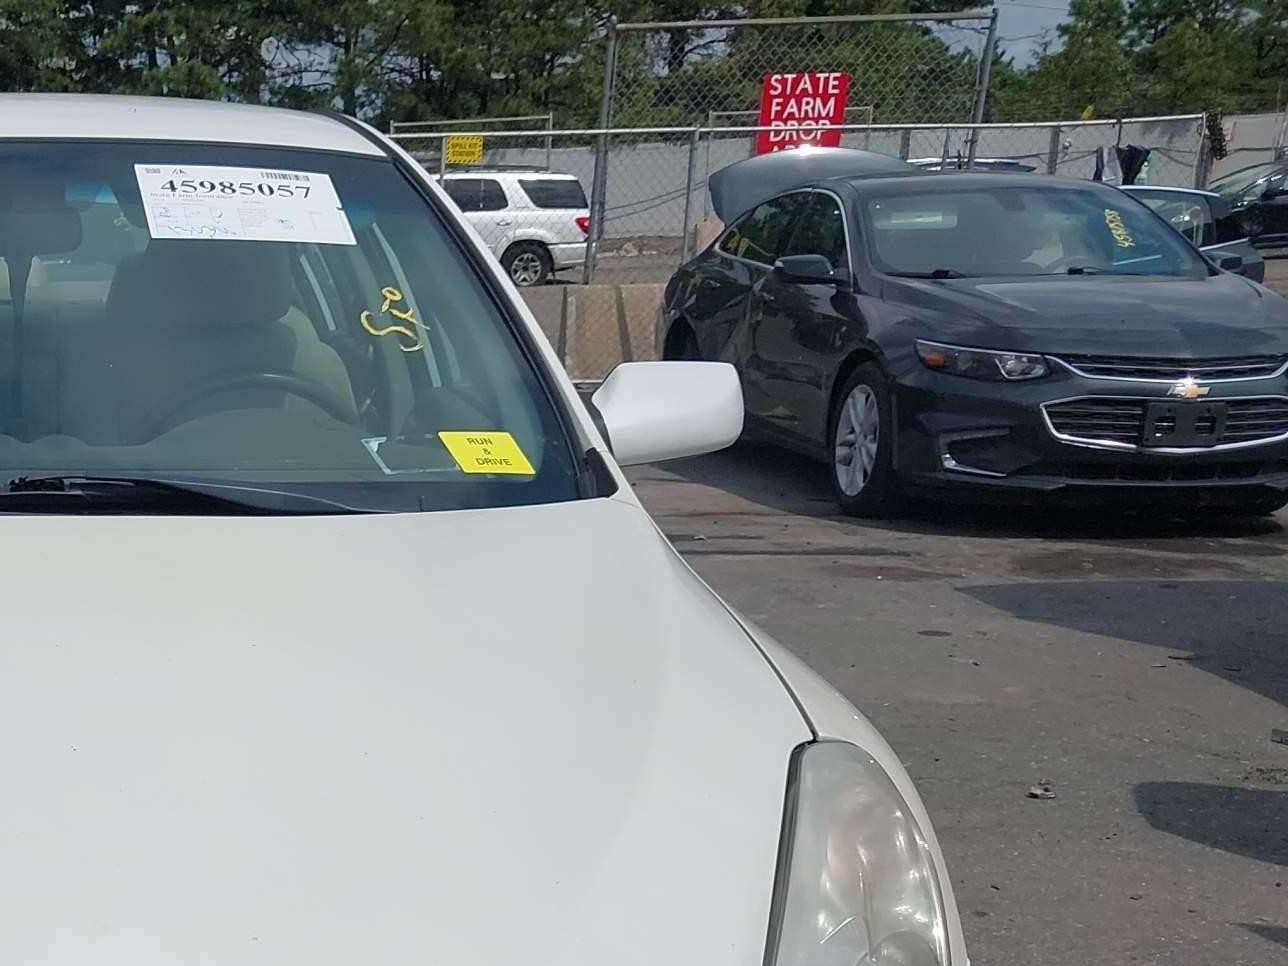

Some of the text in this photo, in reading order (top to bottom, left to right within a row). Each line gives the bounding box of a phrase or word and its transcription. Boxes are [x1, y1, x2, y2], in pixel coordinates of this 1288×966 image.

[769, 72, 841, 95] STATE
[770, 97, 836, 119] FARM
[769, 119, 831, 142] DROP
[160, 179, 311, 199] 45985057
[466, 437, 493, 446] RUN
[483, 447, 492, 455] &
[475, 457, 513, 466] DRIVE
